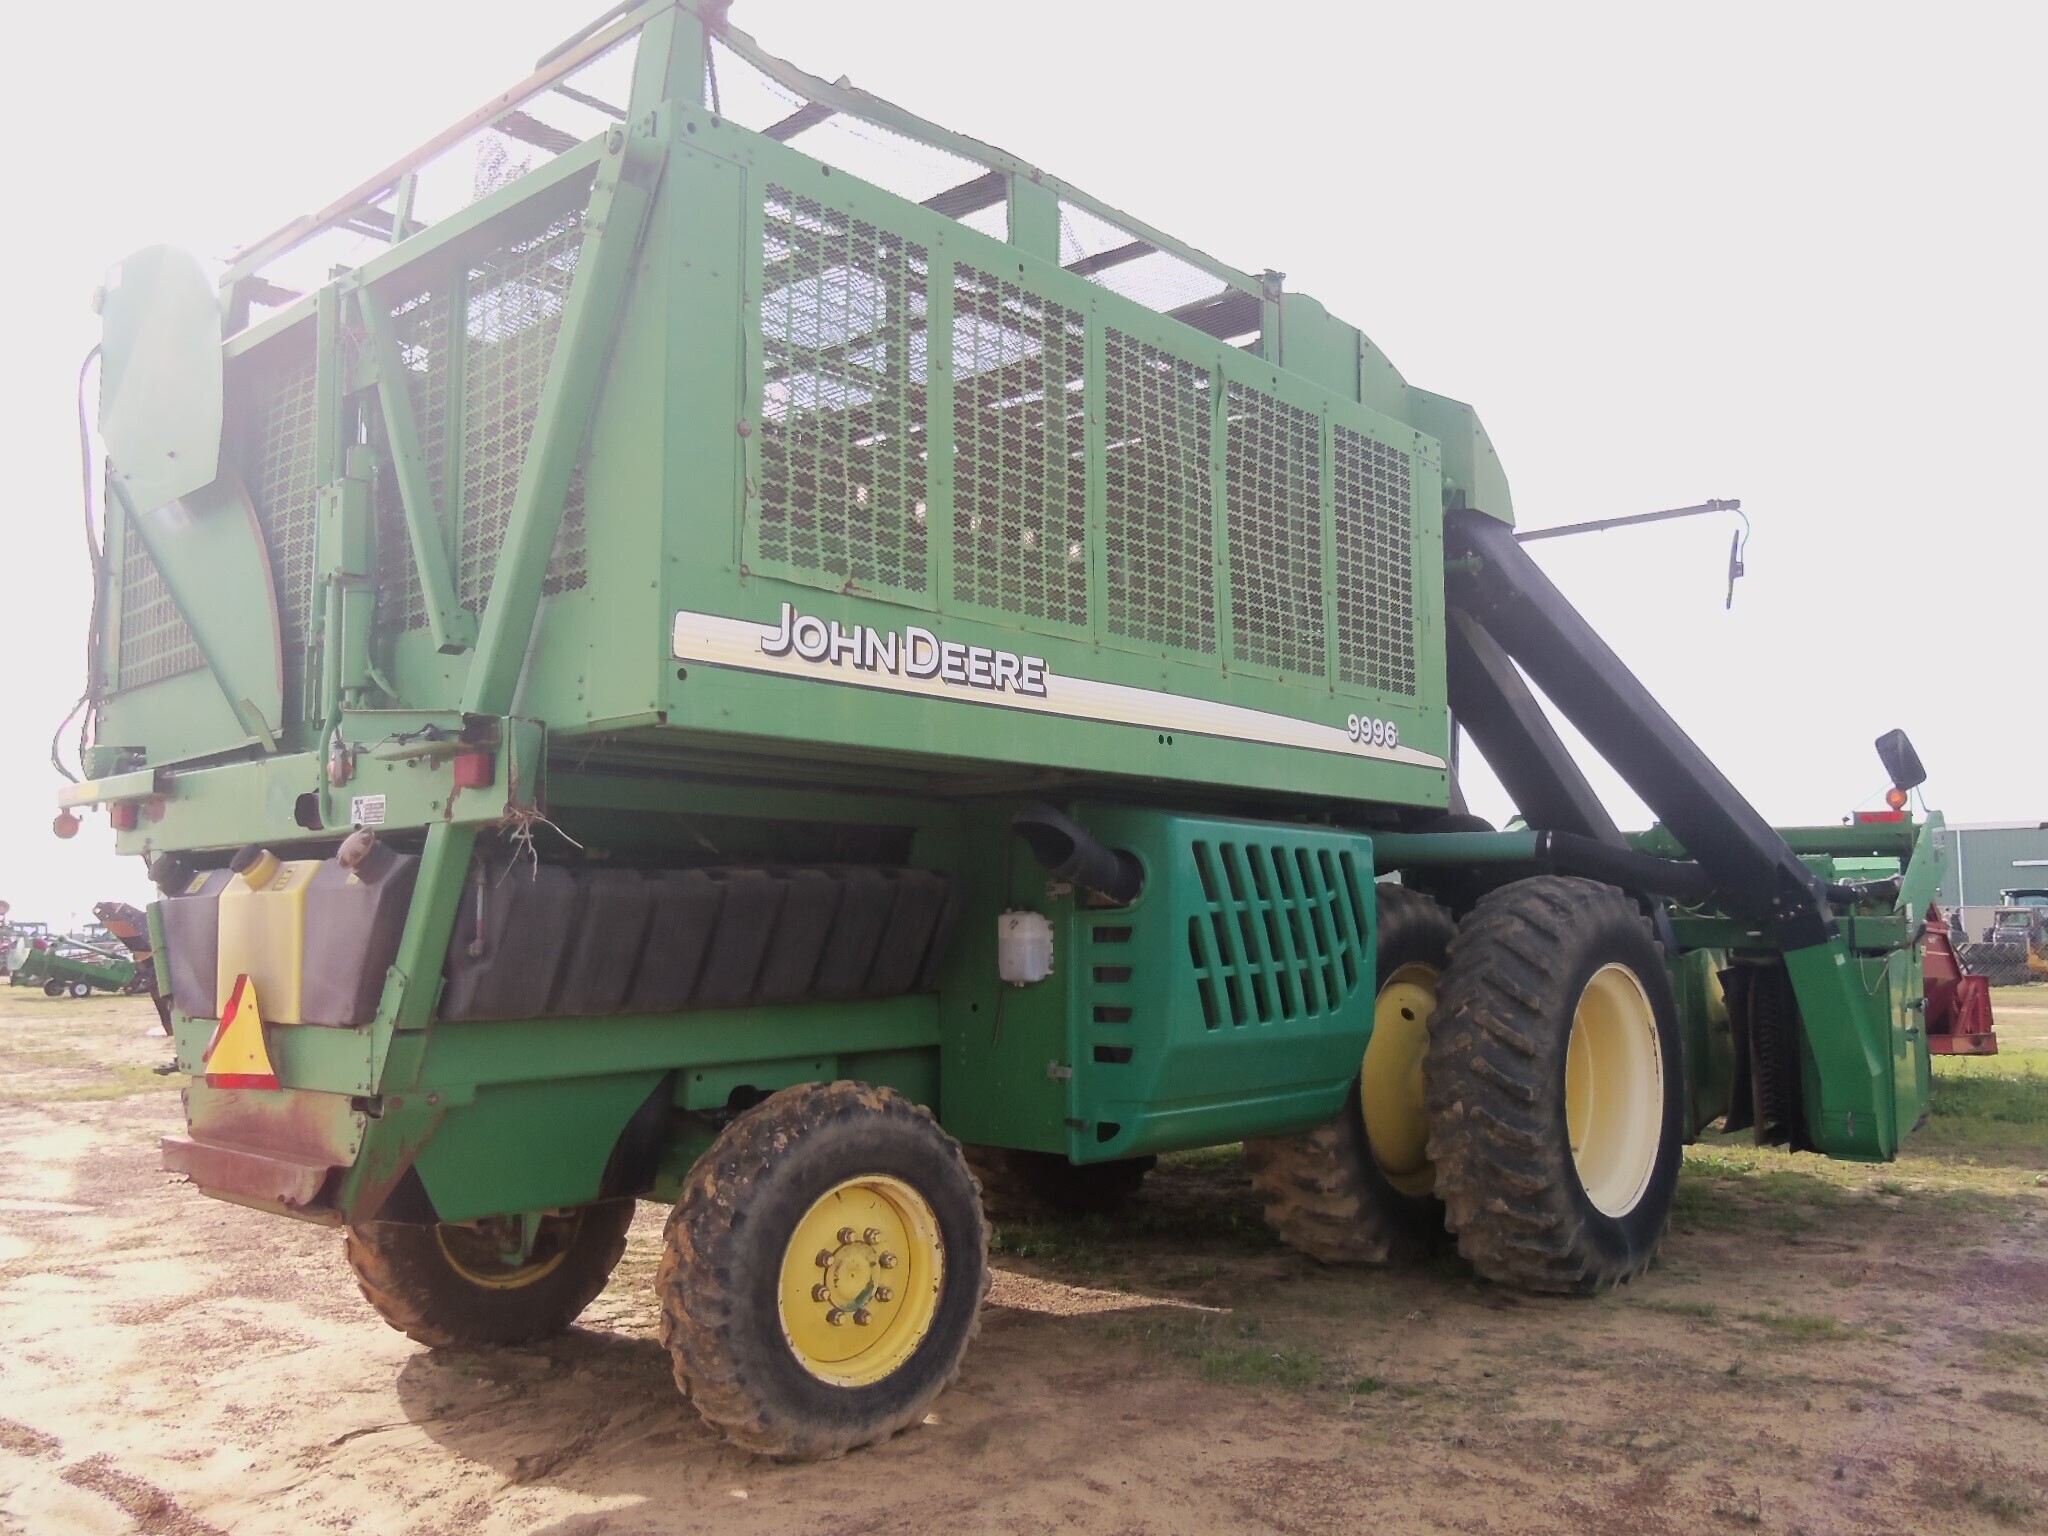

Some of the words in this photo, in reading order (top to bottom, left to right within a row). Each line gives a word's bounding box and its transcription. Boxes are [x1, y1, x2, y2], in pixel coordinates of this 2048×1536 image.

[761, 602, 899, 675] JOHN
[905, 625, 1047, 698] DEERE
[1347, 713, 1398, 749] 9996
